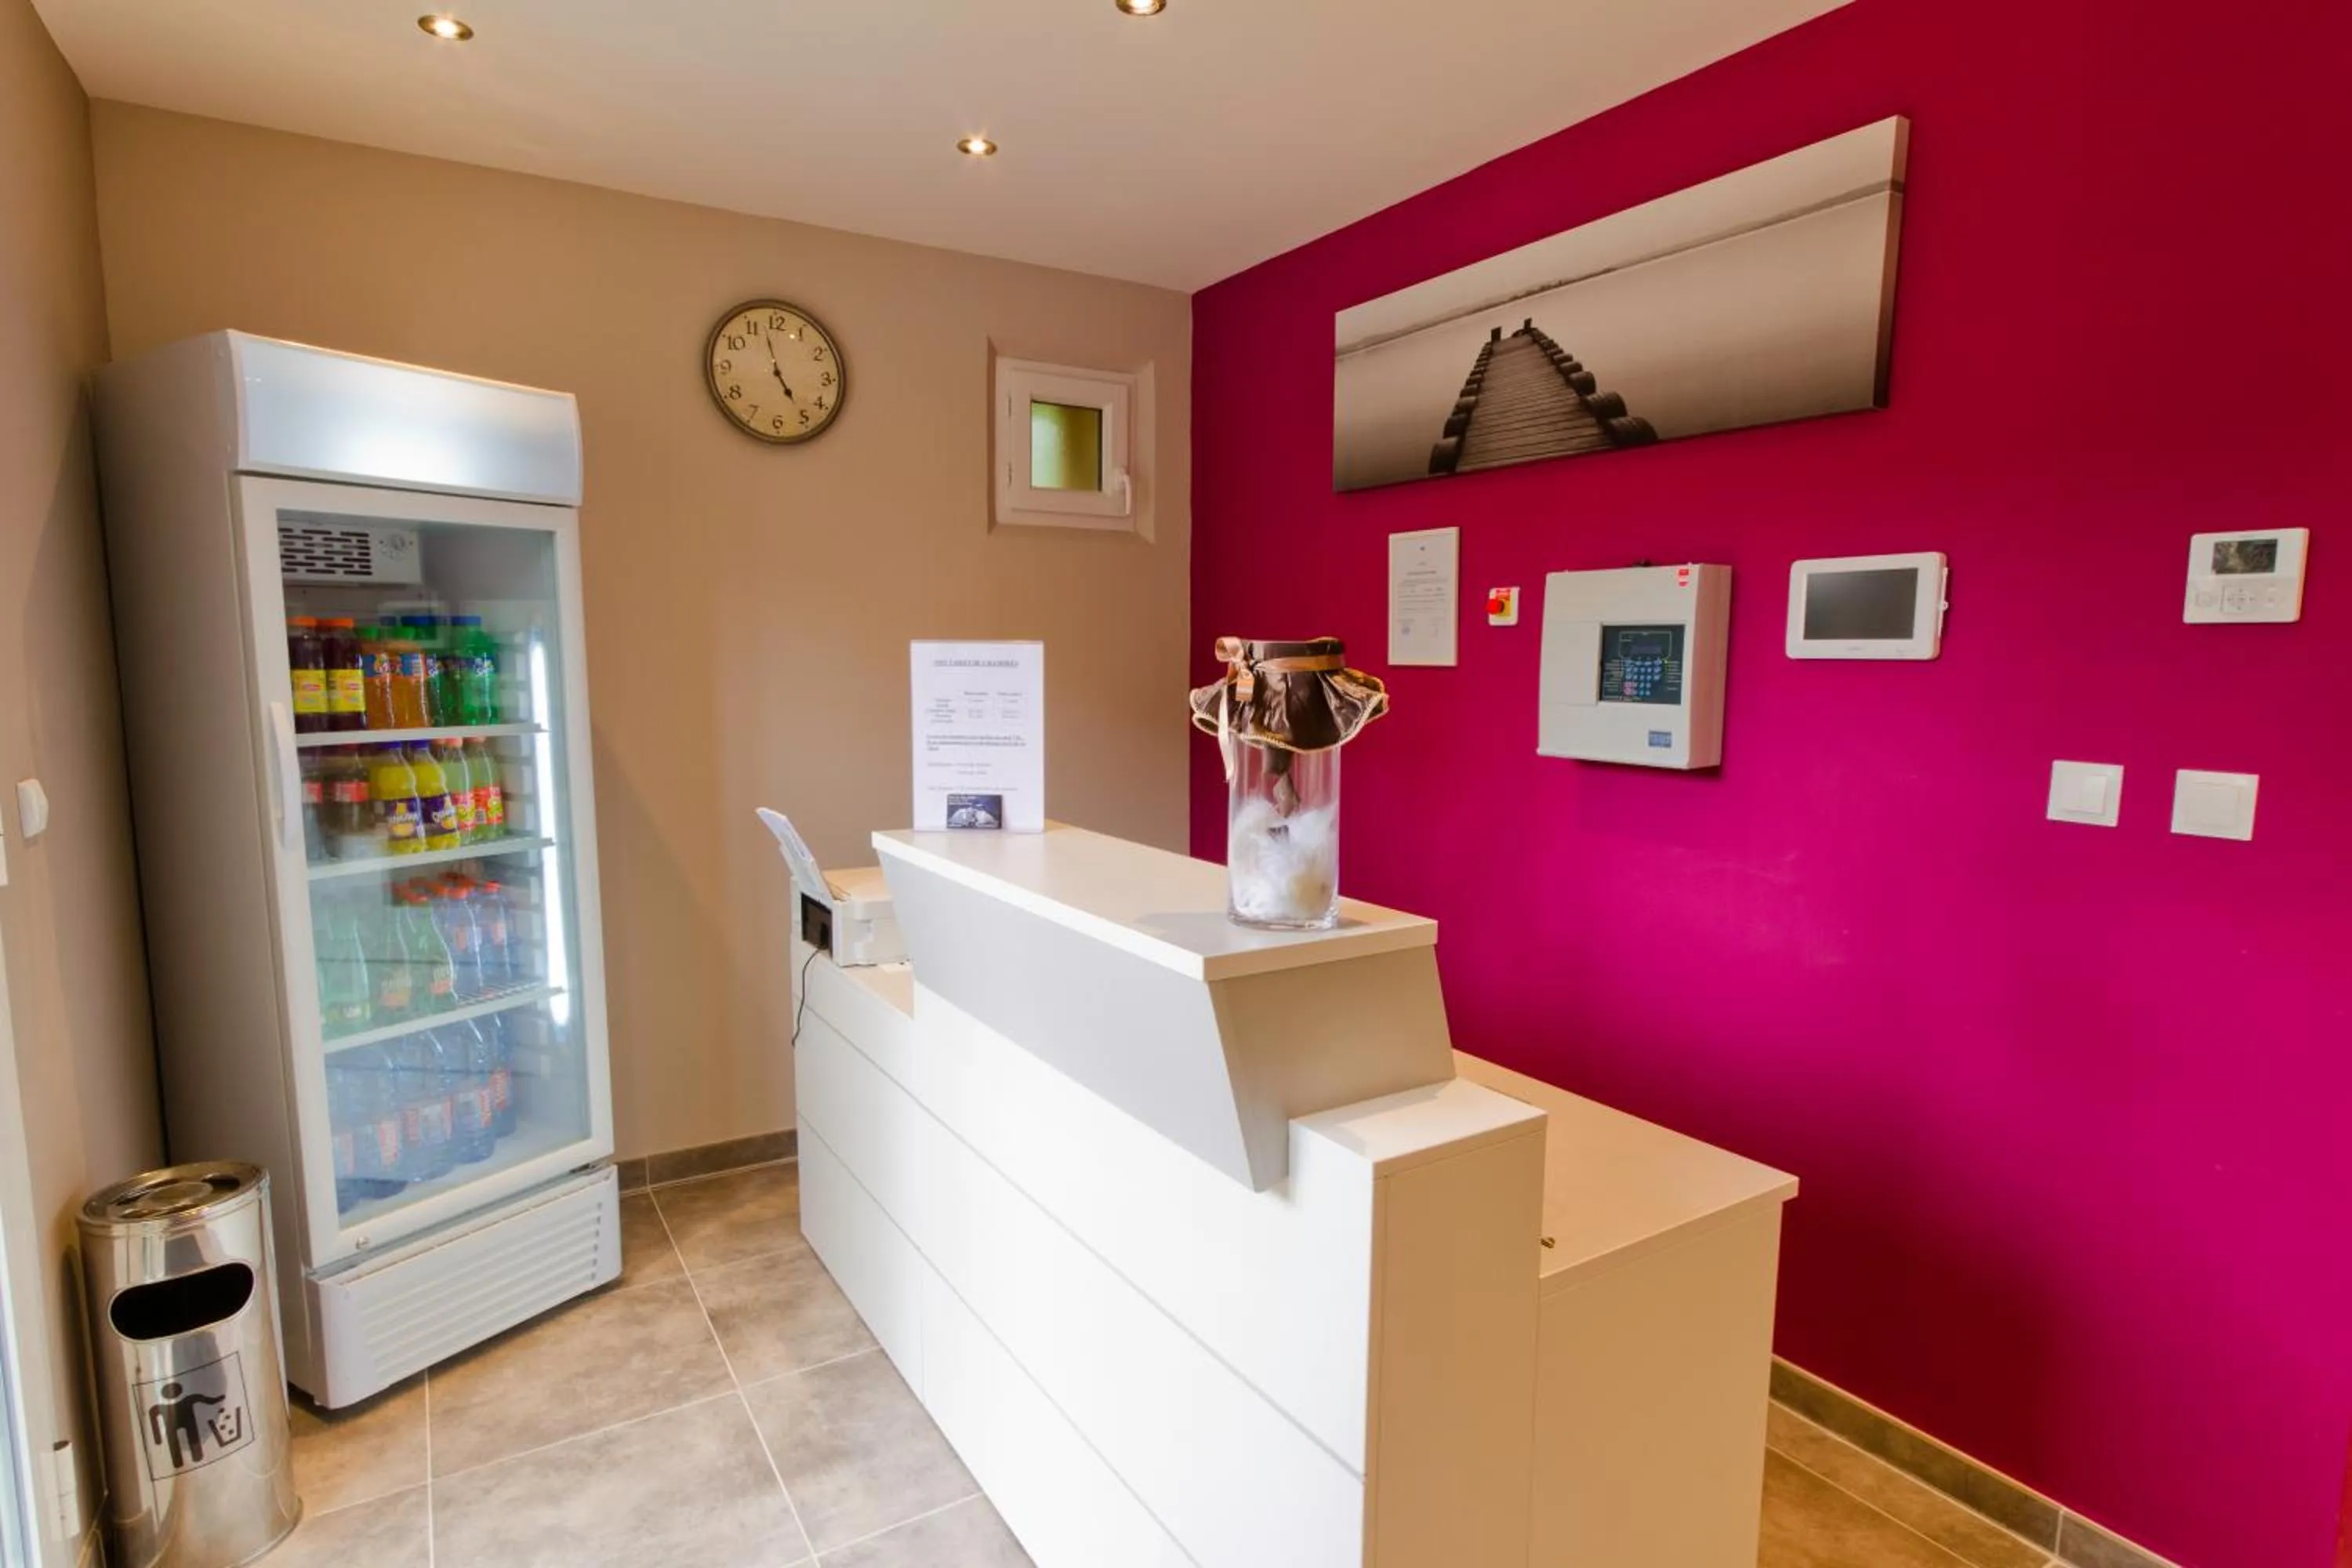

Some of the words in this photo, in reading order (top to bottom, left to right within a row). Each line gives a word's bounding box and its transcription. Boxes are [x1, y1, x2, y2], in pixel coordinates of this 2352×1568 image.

[746, 321, 758, 336] 11
[768, 315, 786, 332] 12
[797, 327, 804, 342] 1
[727, 336, 746, 350] 10
[813, 346, 823, 361] 2
[720, 360, 731, 376] 9
[820, 372, 832, 387] 3
[728, 384, 742, 400] 8
[813, 395, 825, 410] 4
[749, 404, 760, 420] 7
[798, 409, 810, 425] 5
[772, 415, 783, 430] 6
